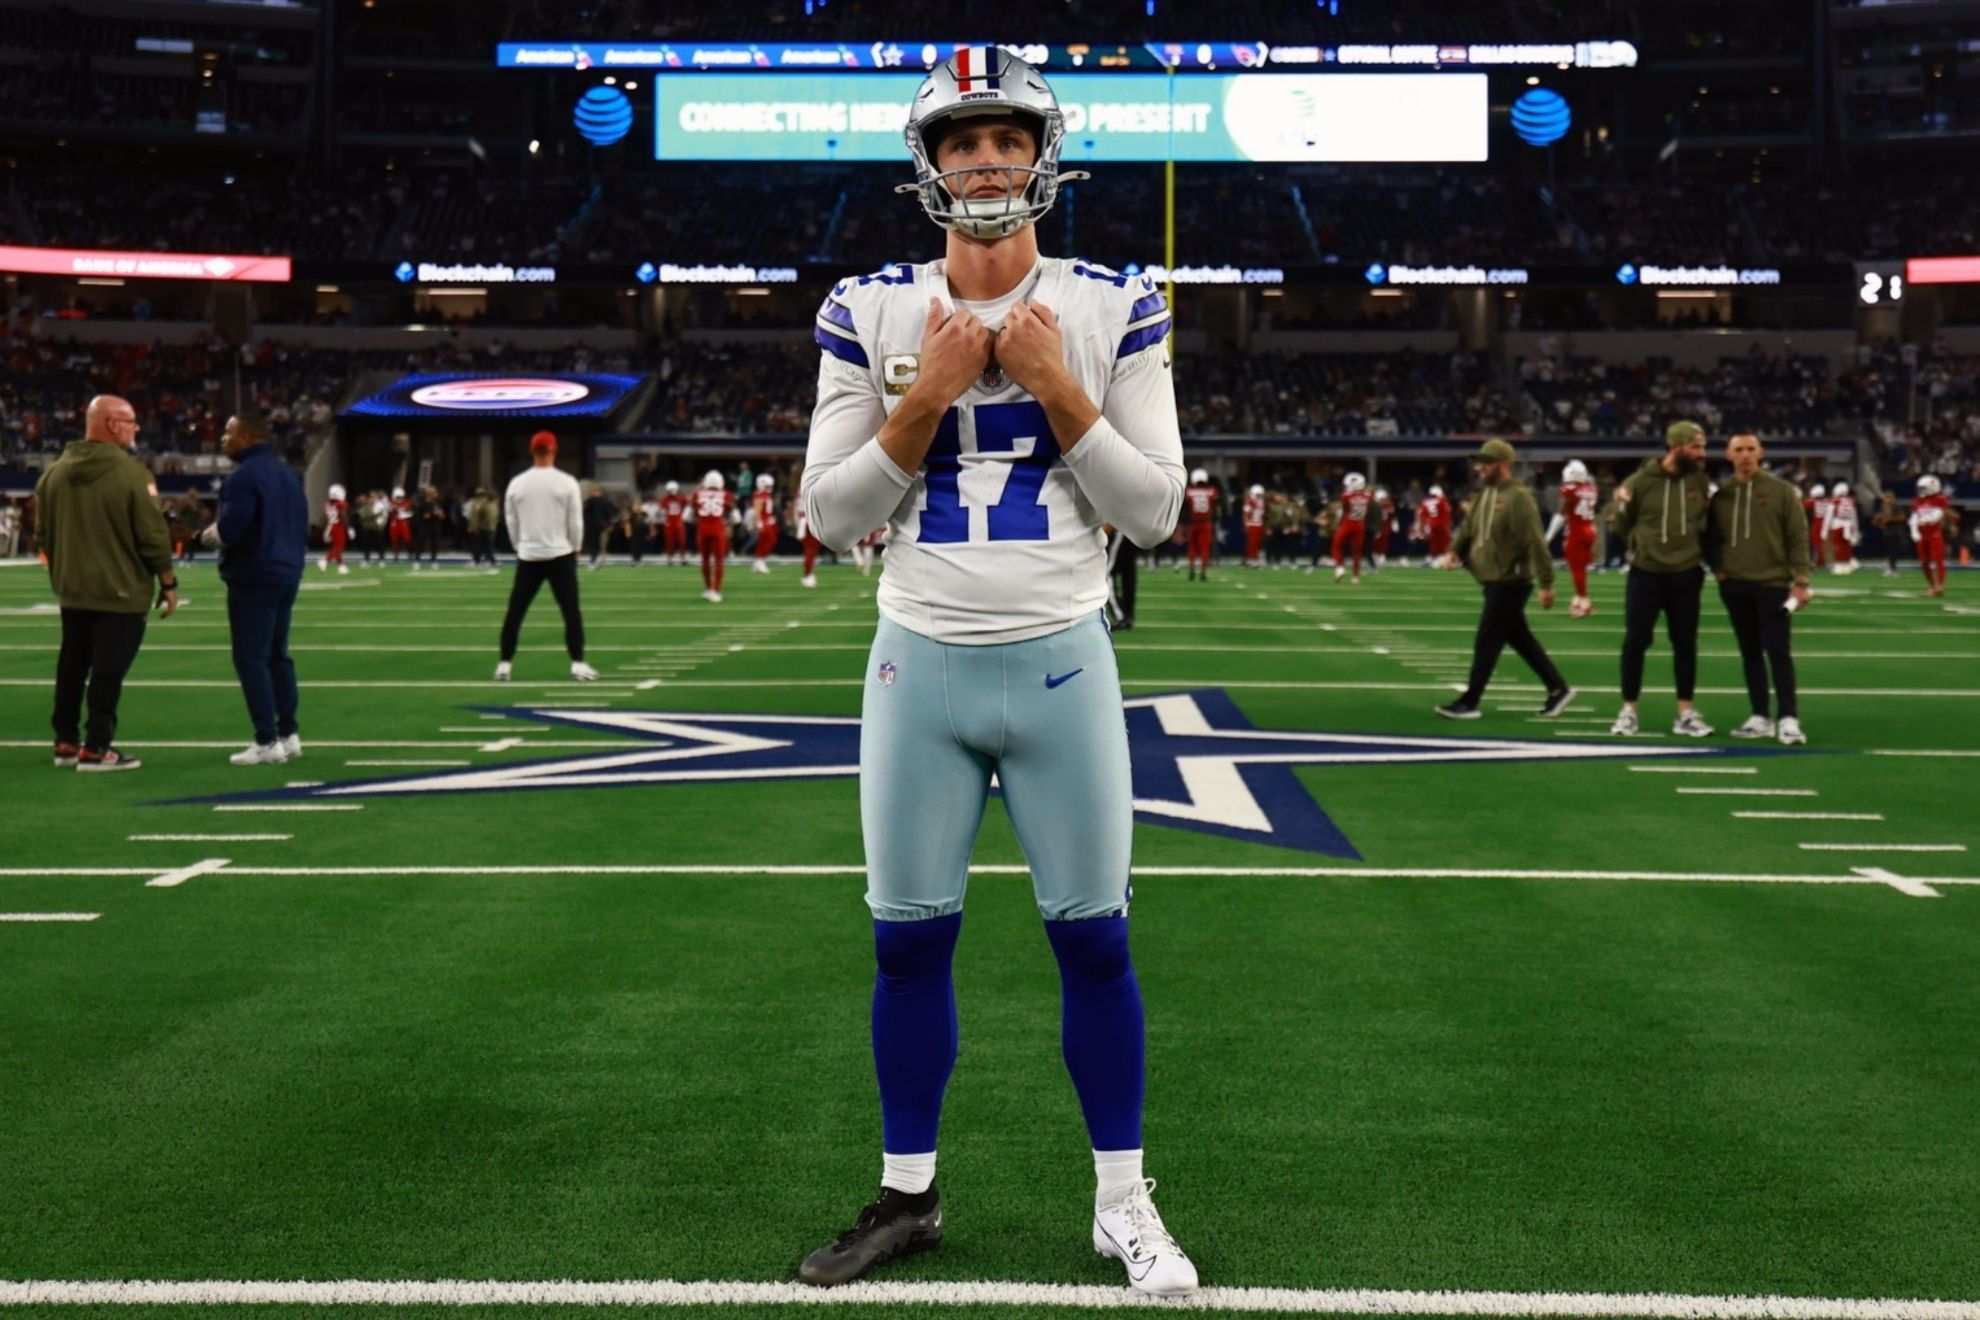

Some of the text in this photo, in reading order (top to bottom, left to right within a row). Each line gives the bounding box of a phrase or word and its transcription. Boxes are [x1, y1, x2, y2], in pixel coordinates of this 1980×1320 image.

[1089, 103, 1211, 132] PRESENT
[884, 356, 918, 384] C
[916, 401, 1062, 543] 17
